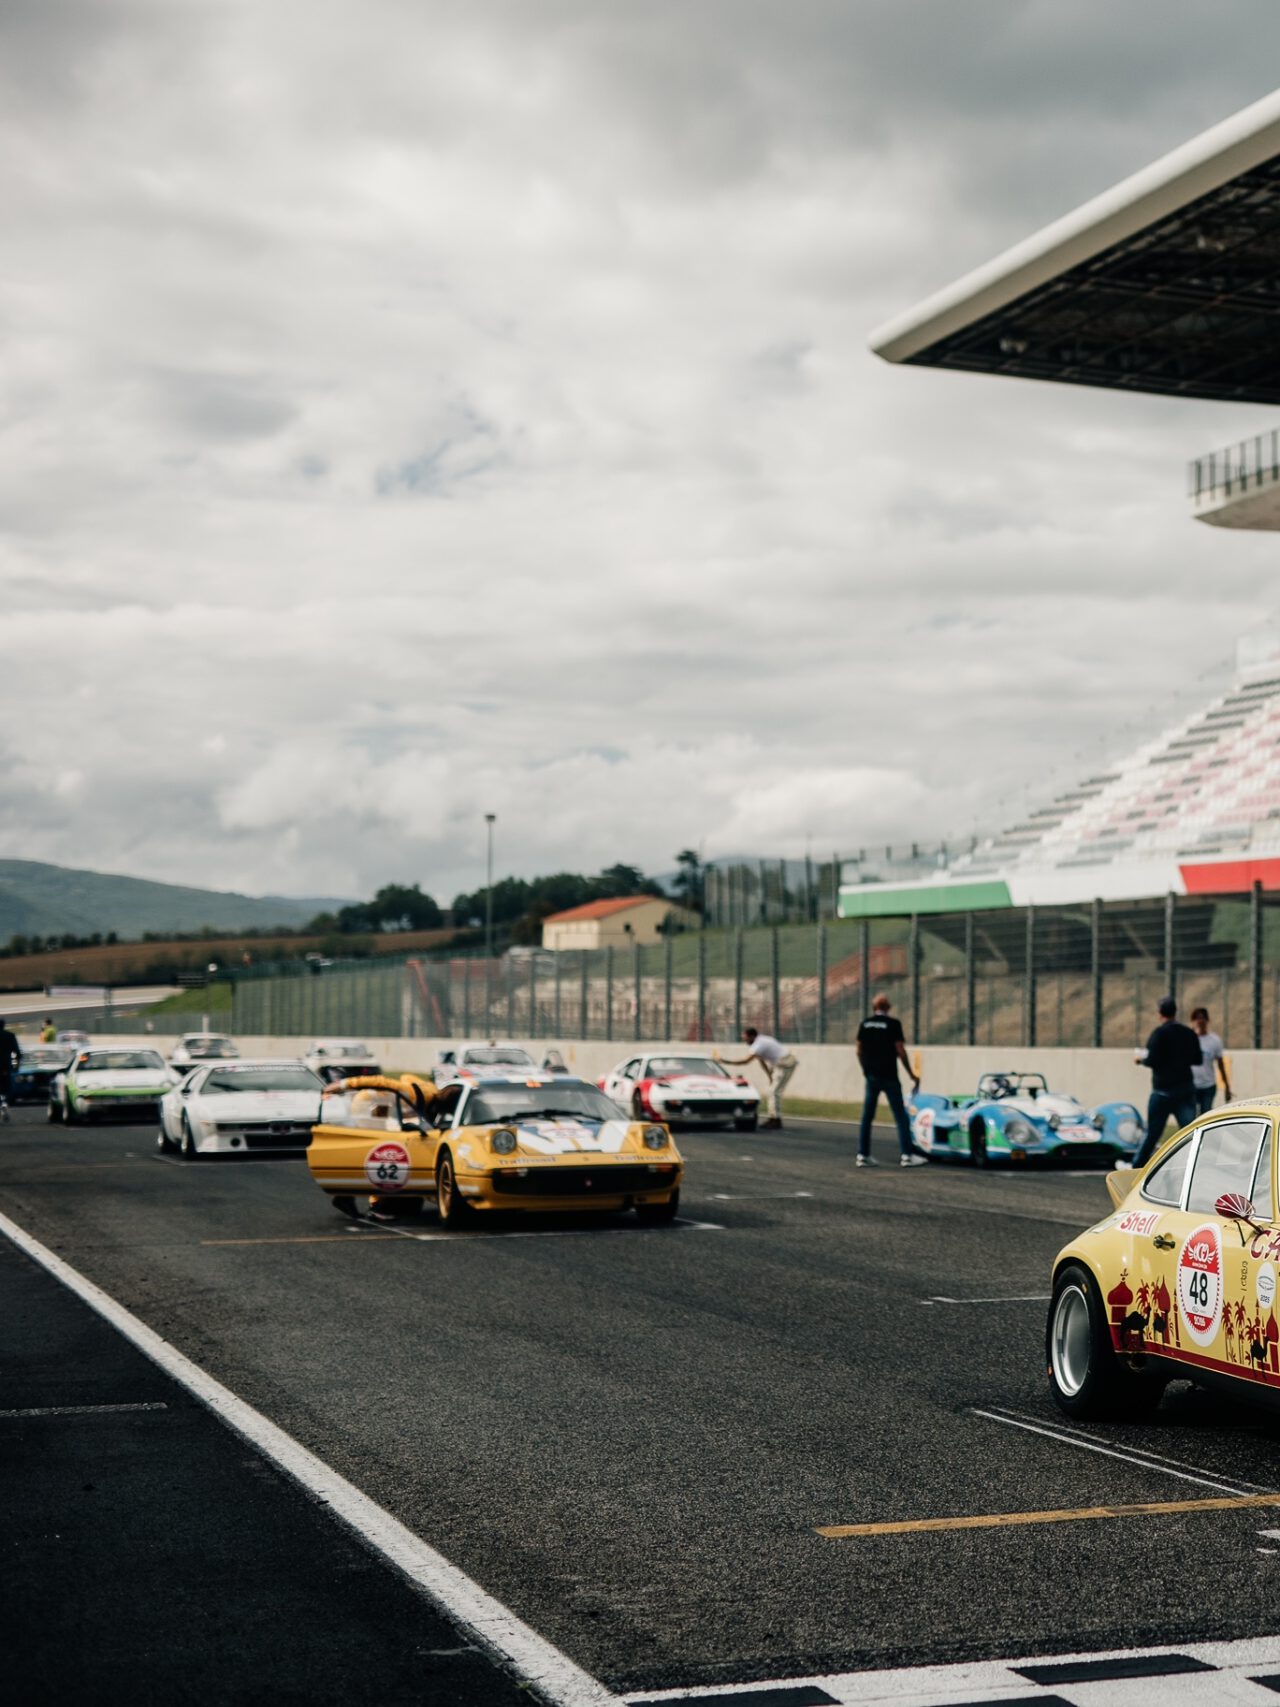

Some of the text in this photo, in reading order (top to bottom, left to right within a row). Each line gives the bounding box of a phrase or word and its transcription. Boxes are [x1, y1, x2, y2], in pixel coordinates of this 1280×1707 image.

[377, 1163, 399, 1180] 62
[1121, 1212, 1159, 1234] Shell
[1189, 1271, 1209, 1308] 48
